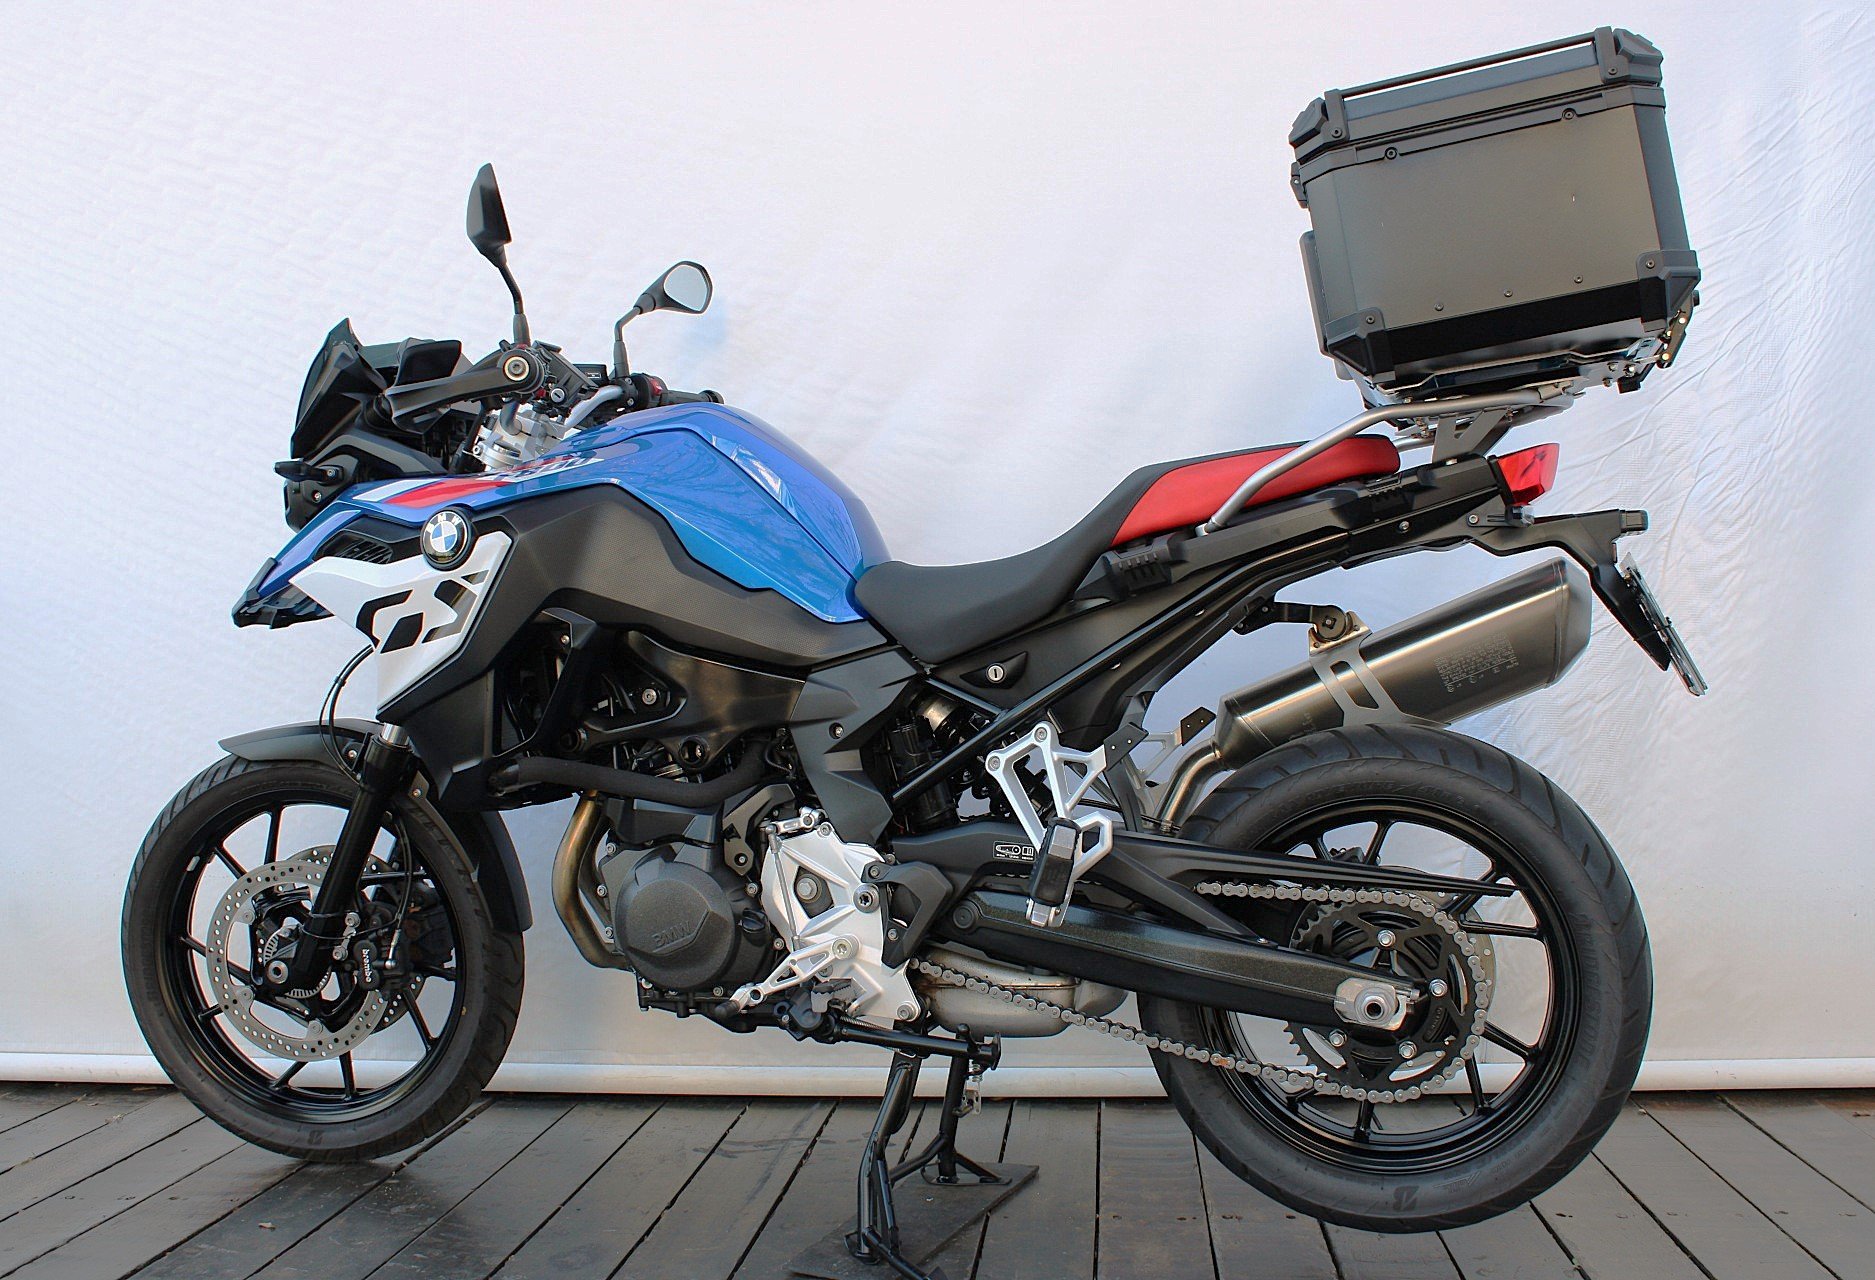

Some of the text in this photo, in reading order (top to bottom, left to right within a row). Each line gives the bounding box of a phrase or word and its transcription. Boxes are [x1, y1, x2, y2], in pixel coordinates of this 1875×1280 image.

[426, 512, 463, 534] BMW
[652, 921, 691, 949] BMW
[361, 948, 372, 983] brembo
